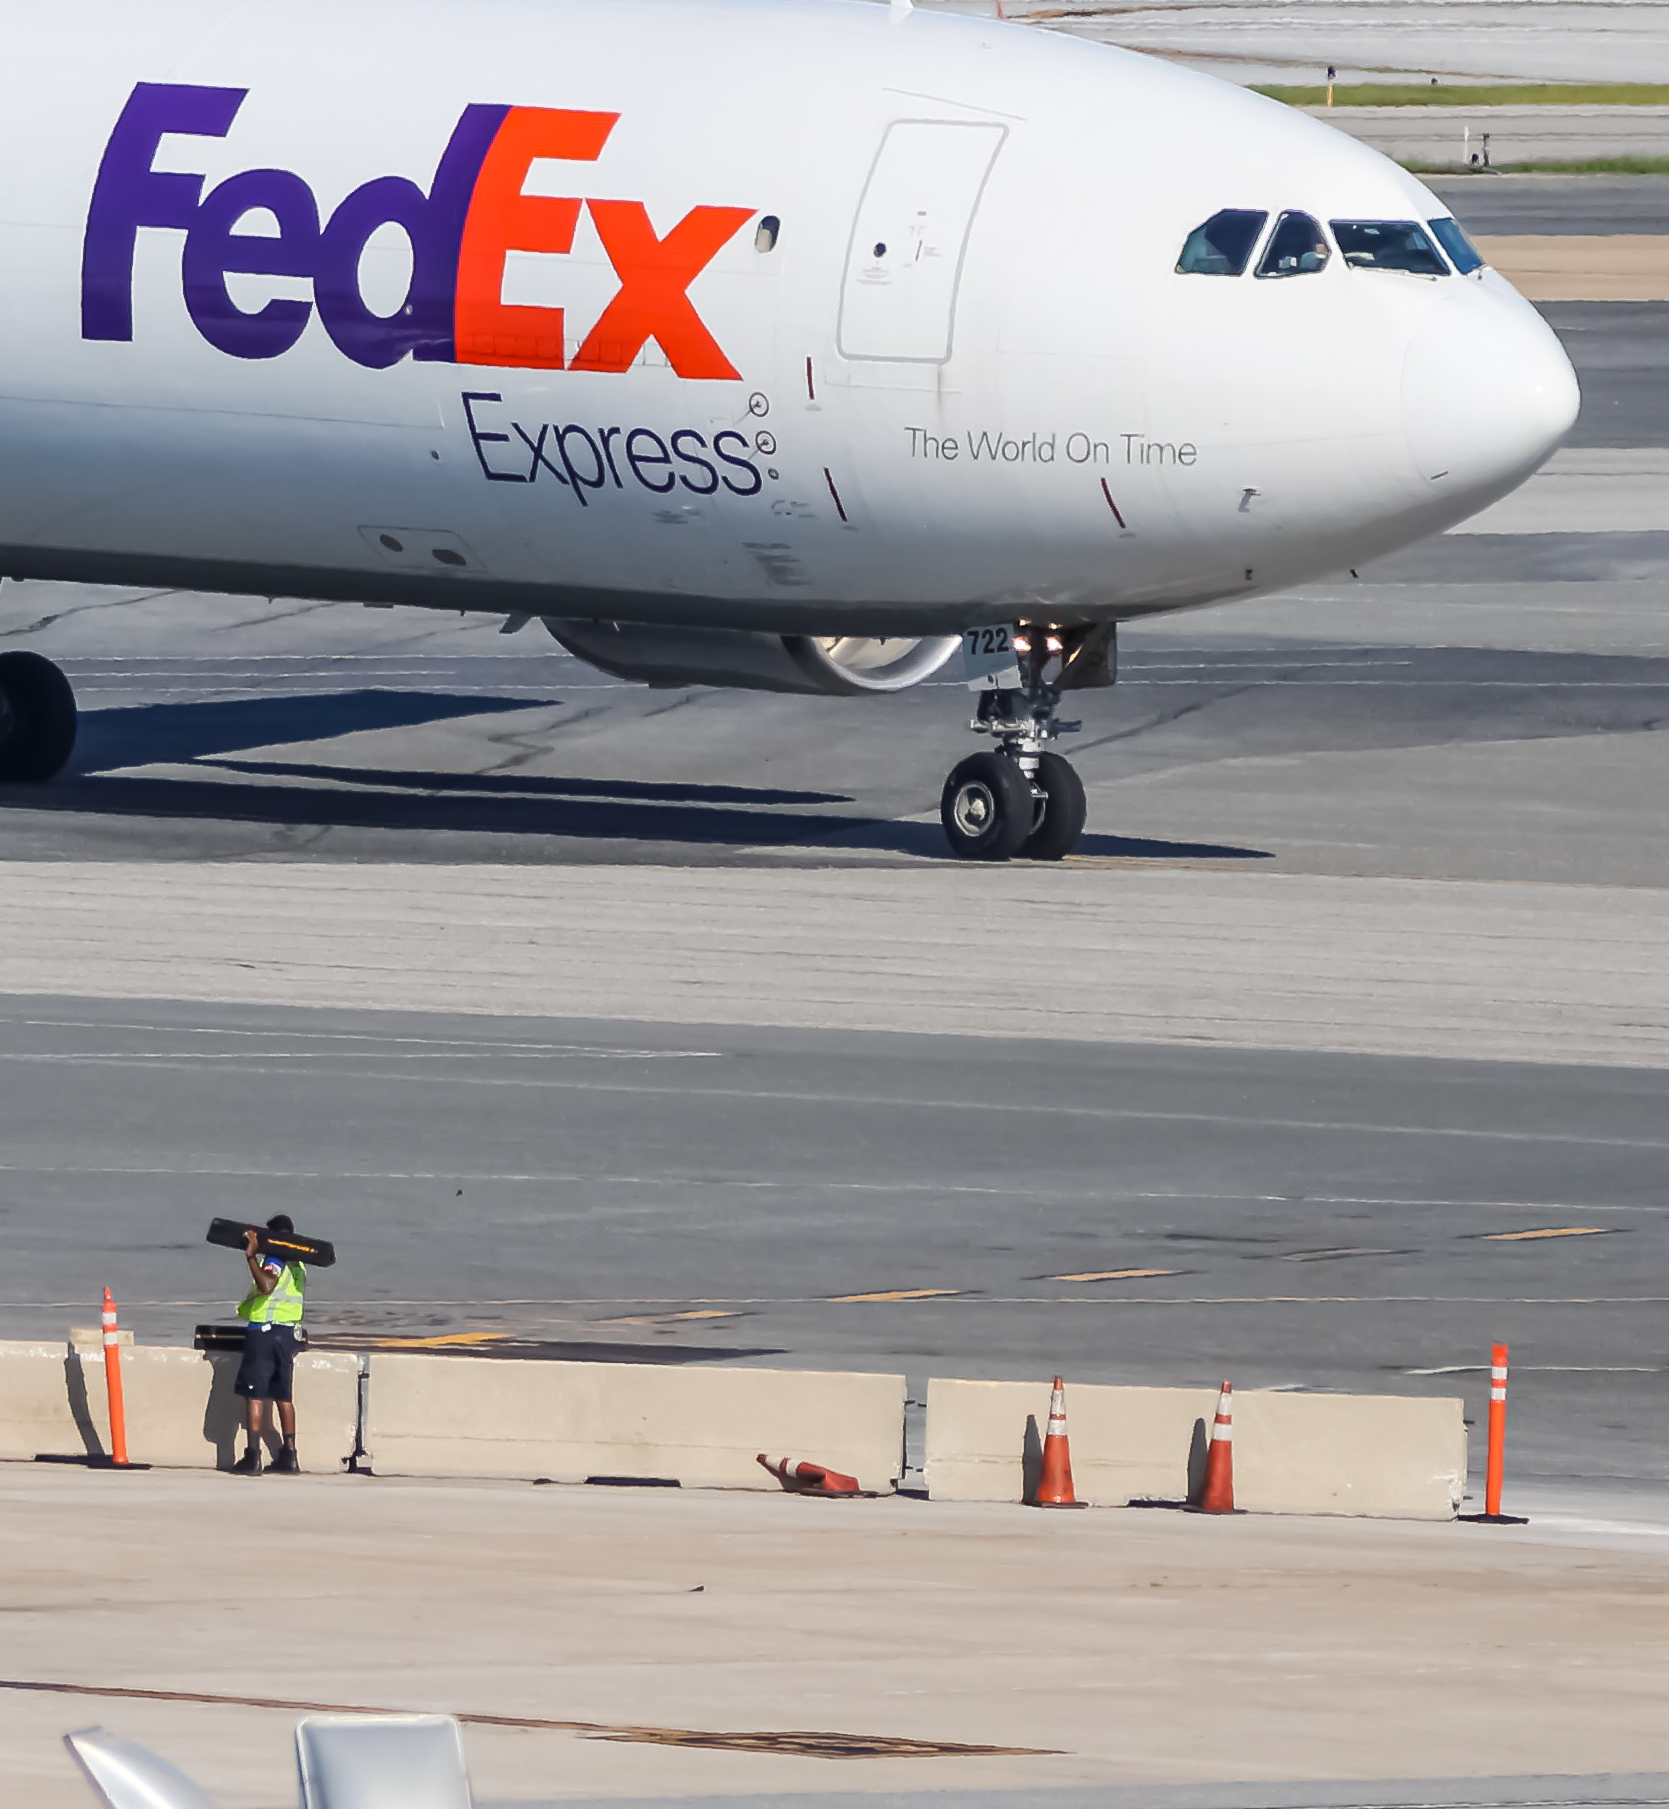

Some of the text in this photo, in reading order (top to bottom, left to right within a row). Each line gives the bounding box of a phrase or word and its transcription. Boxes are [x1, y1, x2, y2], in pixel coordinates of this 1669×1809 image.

[81, 81, 759, 380] FedEx
[461, 391, 763, 507] Express
[904, 426, 1198, 467] The World On Time
[967, 627, 1009, 656] 722
